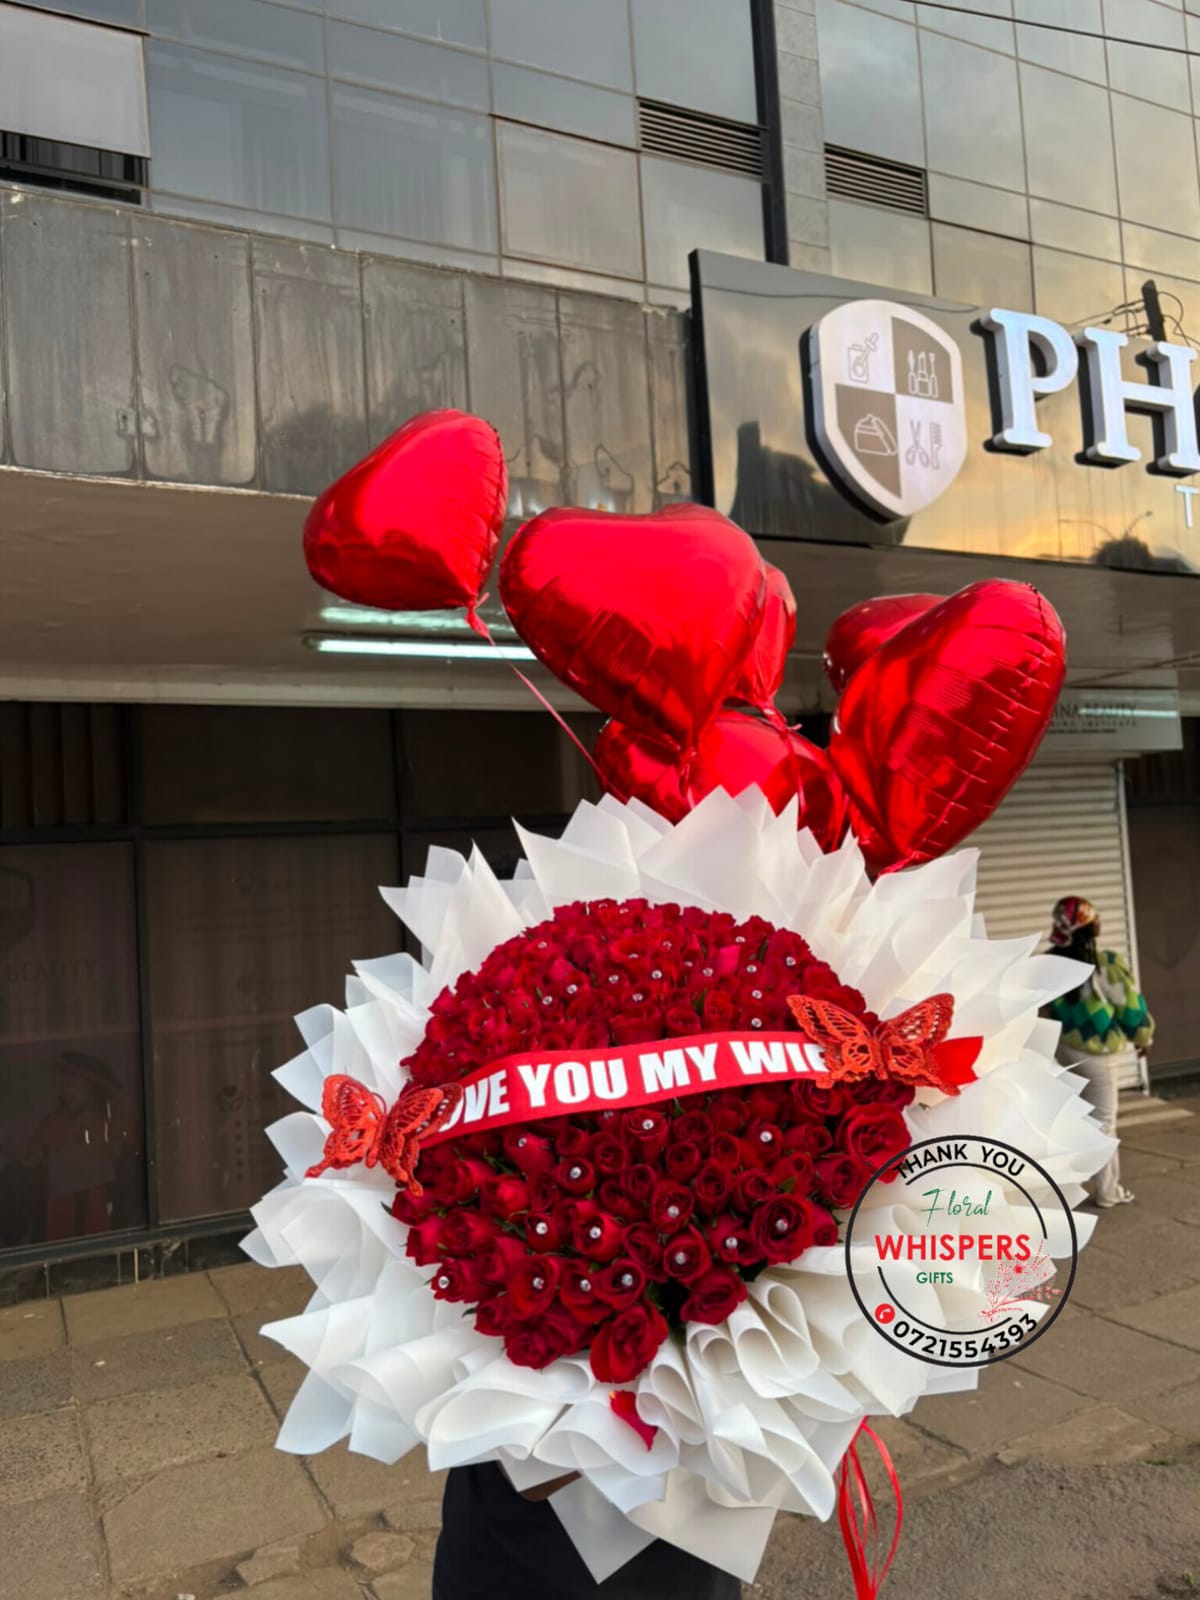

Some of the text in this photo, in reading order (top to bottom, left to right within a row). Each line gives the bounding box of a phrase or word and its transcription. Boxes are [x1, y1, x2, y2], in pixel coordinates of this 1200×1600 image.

[985, 308, 1200, 471] PH
[516, 1058, 628, 1108] YOU
[640, 1040, 719, 1093] MY
